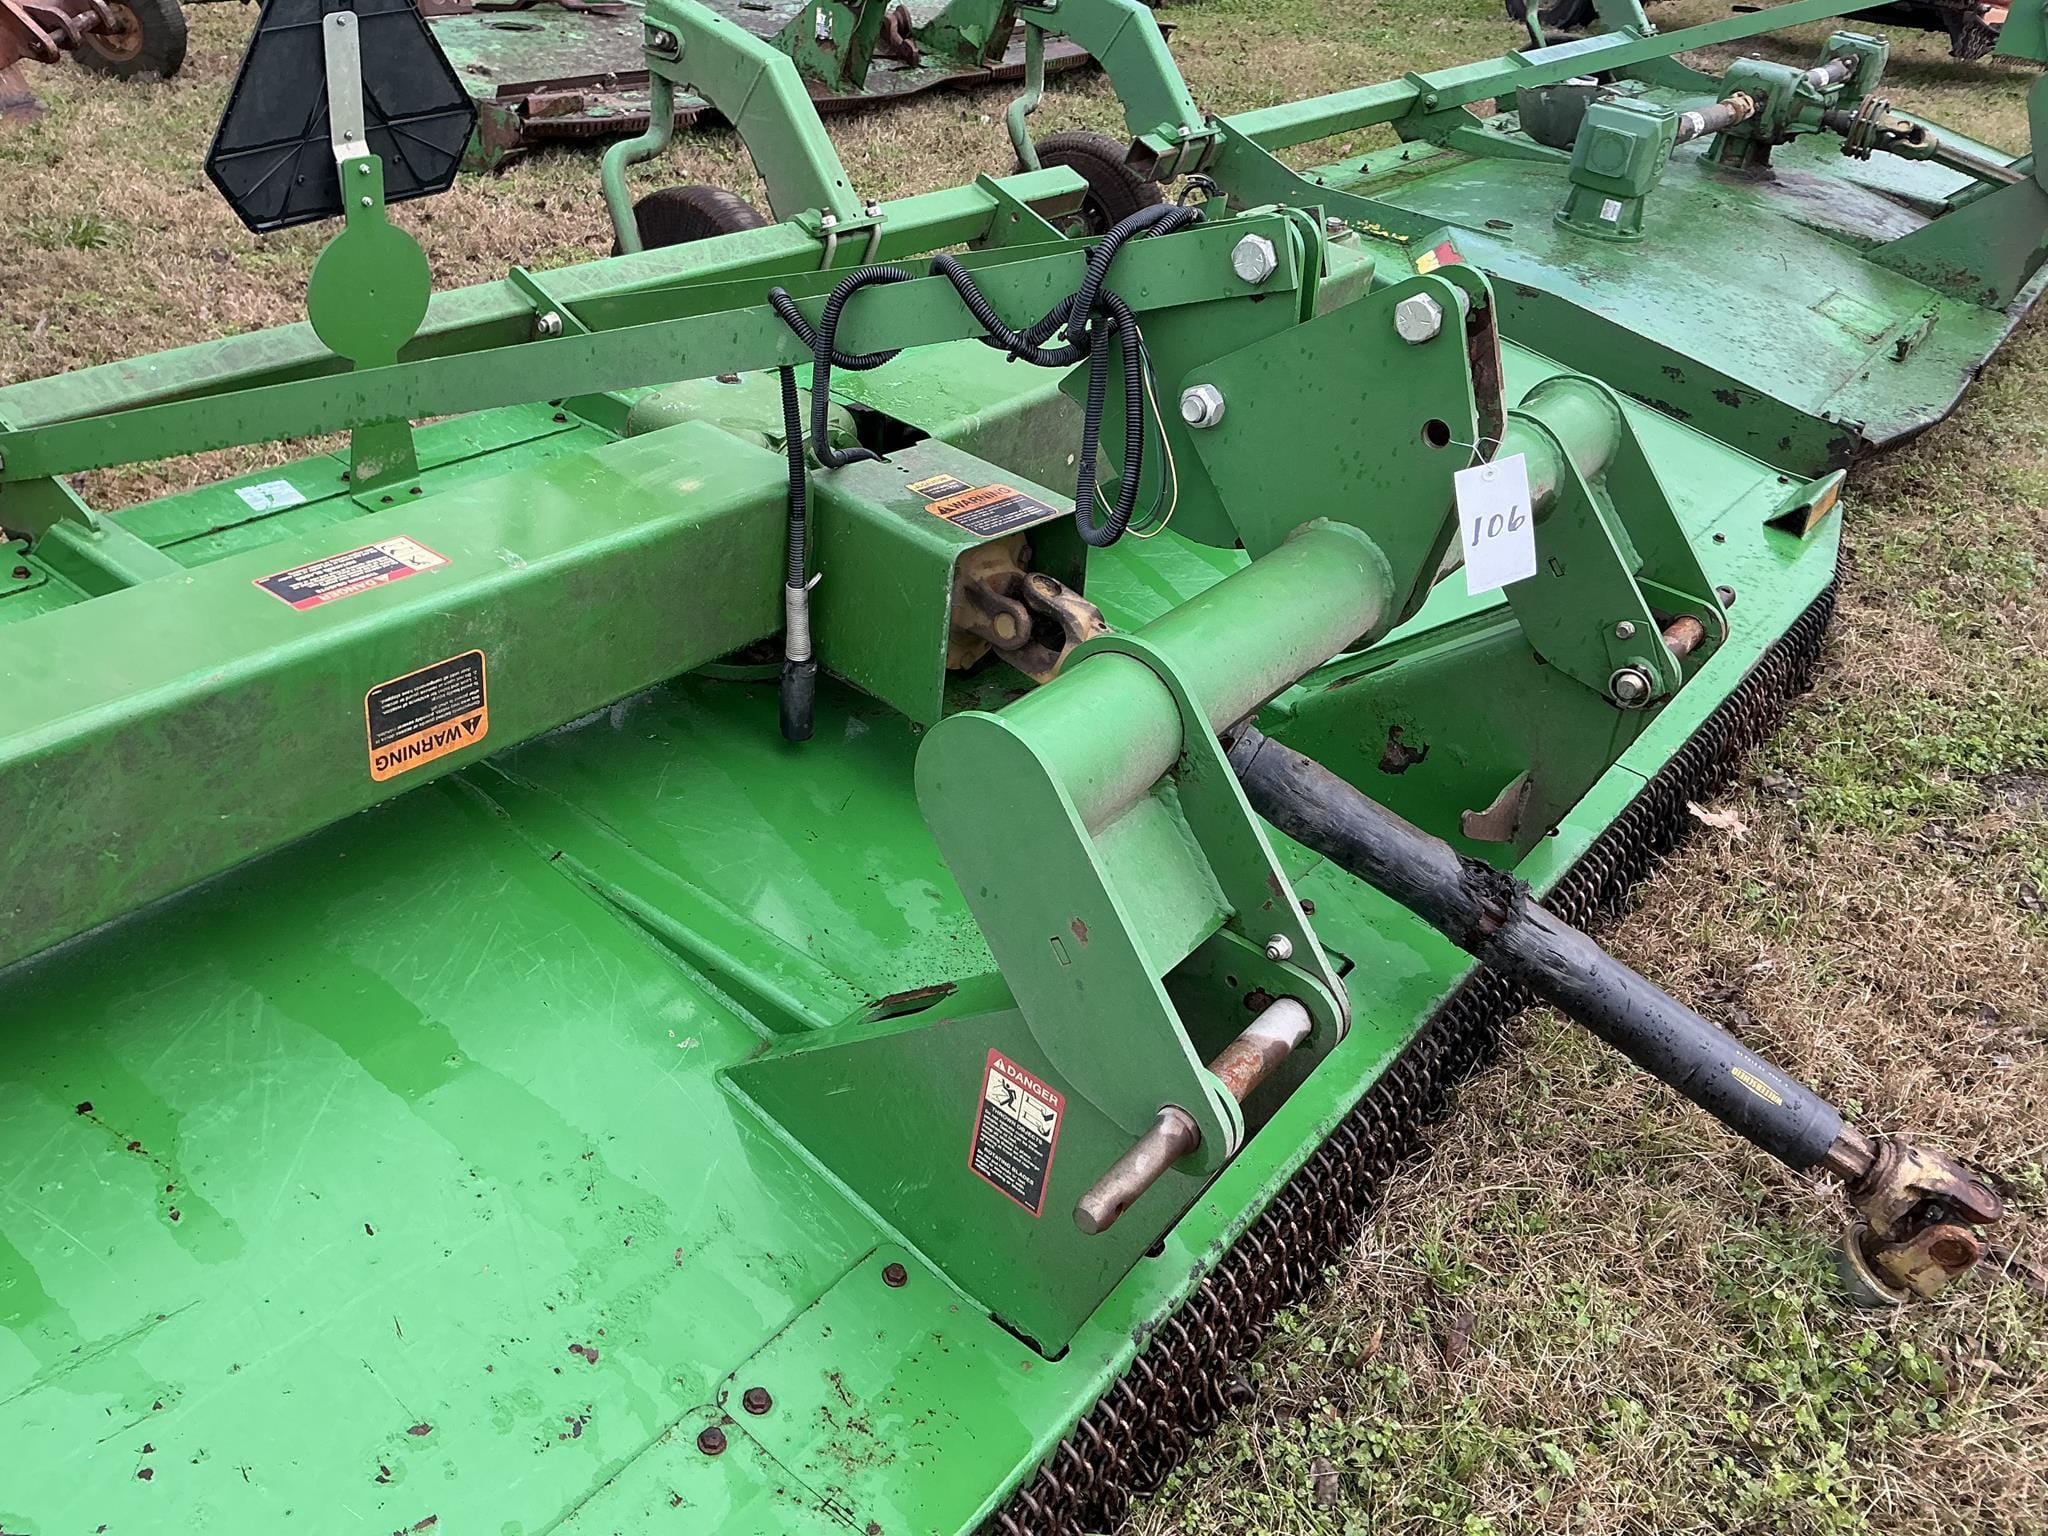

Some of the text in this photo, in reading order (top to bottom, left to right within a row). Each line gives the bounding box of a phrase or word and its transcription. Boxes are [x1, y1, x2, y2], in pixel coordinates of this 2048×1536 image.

[949, 488, 1011, 510] WARNING
[1472, 505, 1525, 547] 106
[321, 578, 378, 601] DANGER
[376, 725, 462, 771] WARNING
[1006, 1064, 1059, 1107] DANGER
[992, 1106, 1016, 1126] THROWN
[1016, 1123, 1042, 1145] OBJECTS
[983, 1146, 1011, 1169] ROTATING
[1011, 1166, 1033, 1185] BLADES
